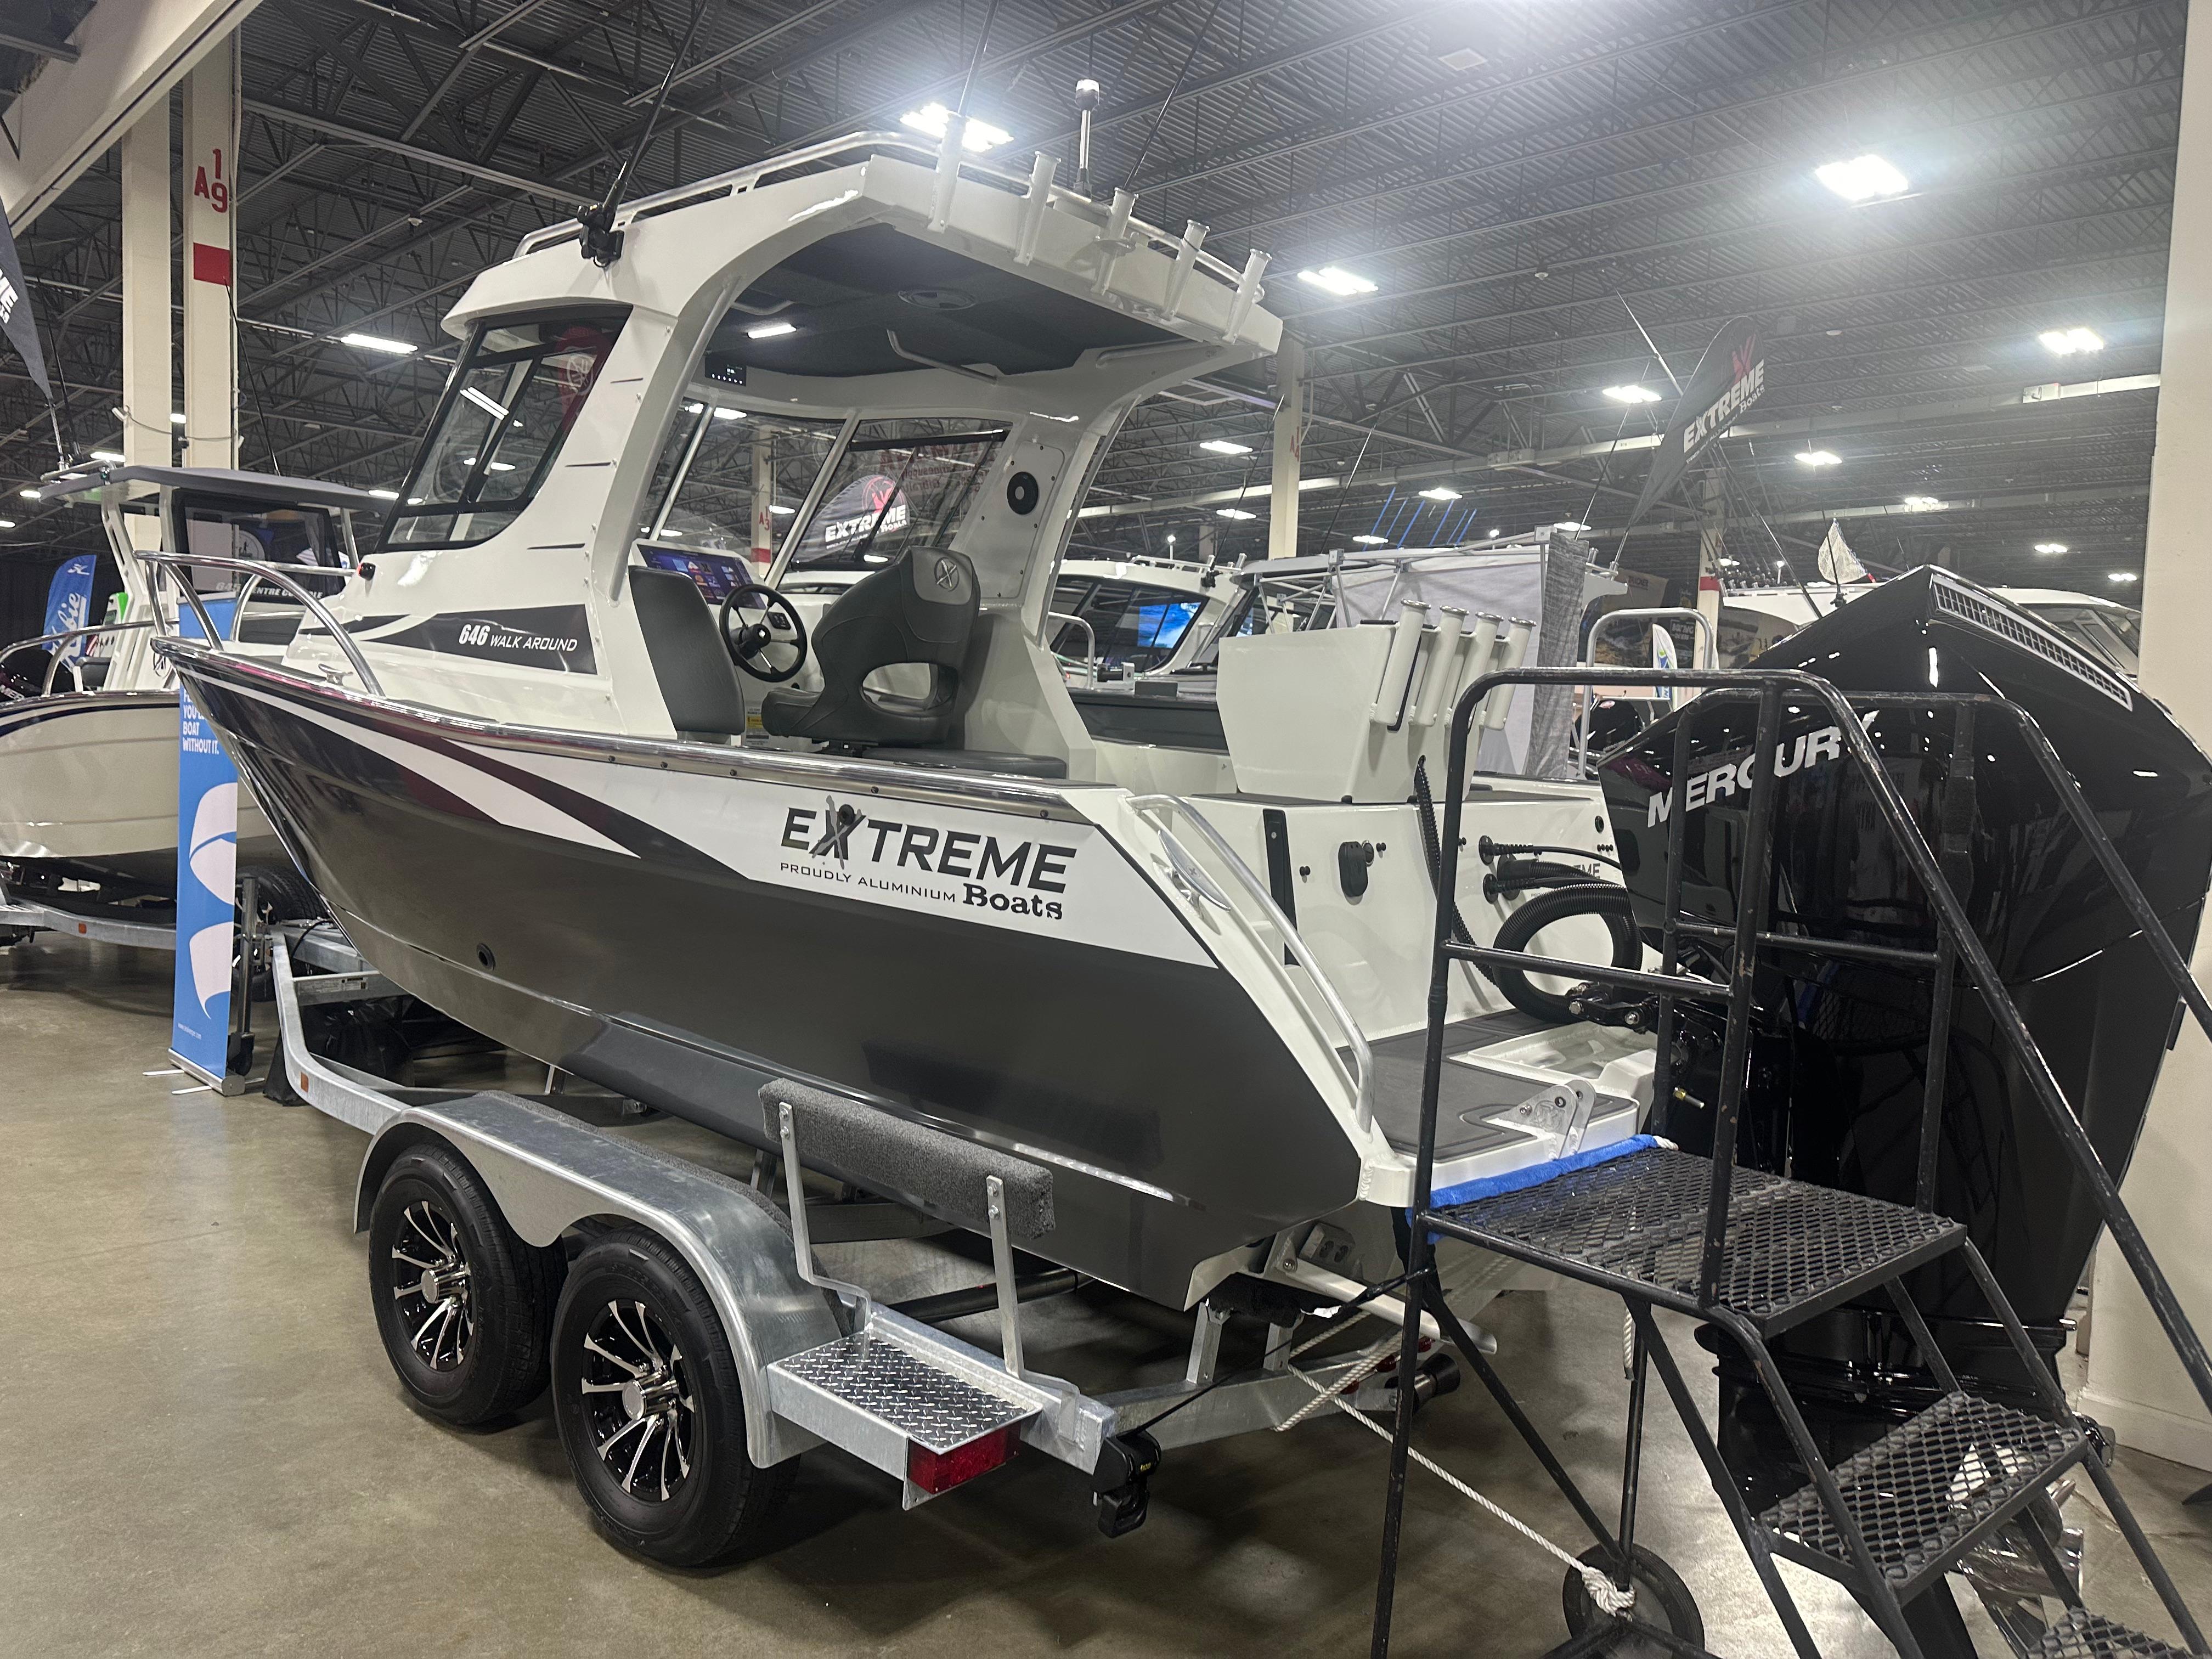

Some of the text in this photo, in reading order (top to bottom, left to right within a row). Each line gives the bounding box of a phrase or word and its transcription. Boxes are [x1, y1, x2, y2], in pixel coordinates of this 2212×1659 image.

[1683, 358, 1765, 454] EXTREME
[458, 624, 578, 652] 646 WALK AROUND
[182, 737, 211, 754] WITHOUT
[183, 721, 200, 736] BOAT
[781, 795, 1077, 894] EXTREME
[780, 862, 956, 903] PROUDLY ALUMINIUM
[962, 882, 1064, 921] Boats
